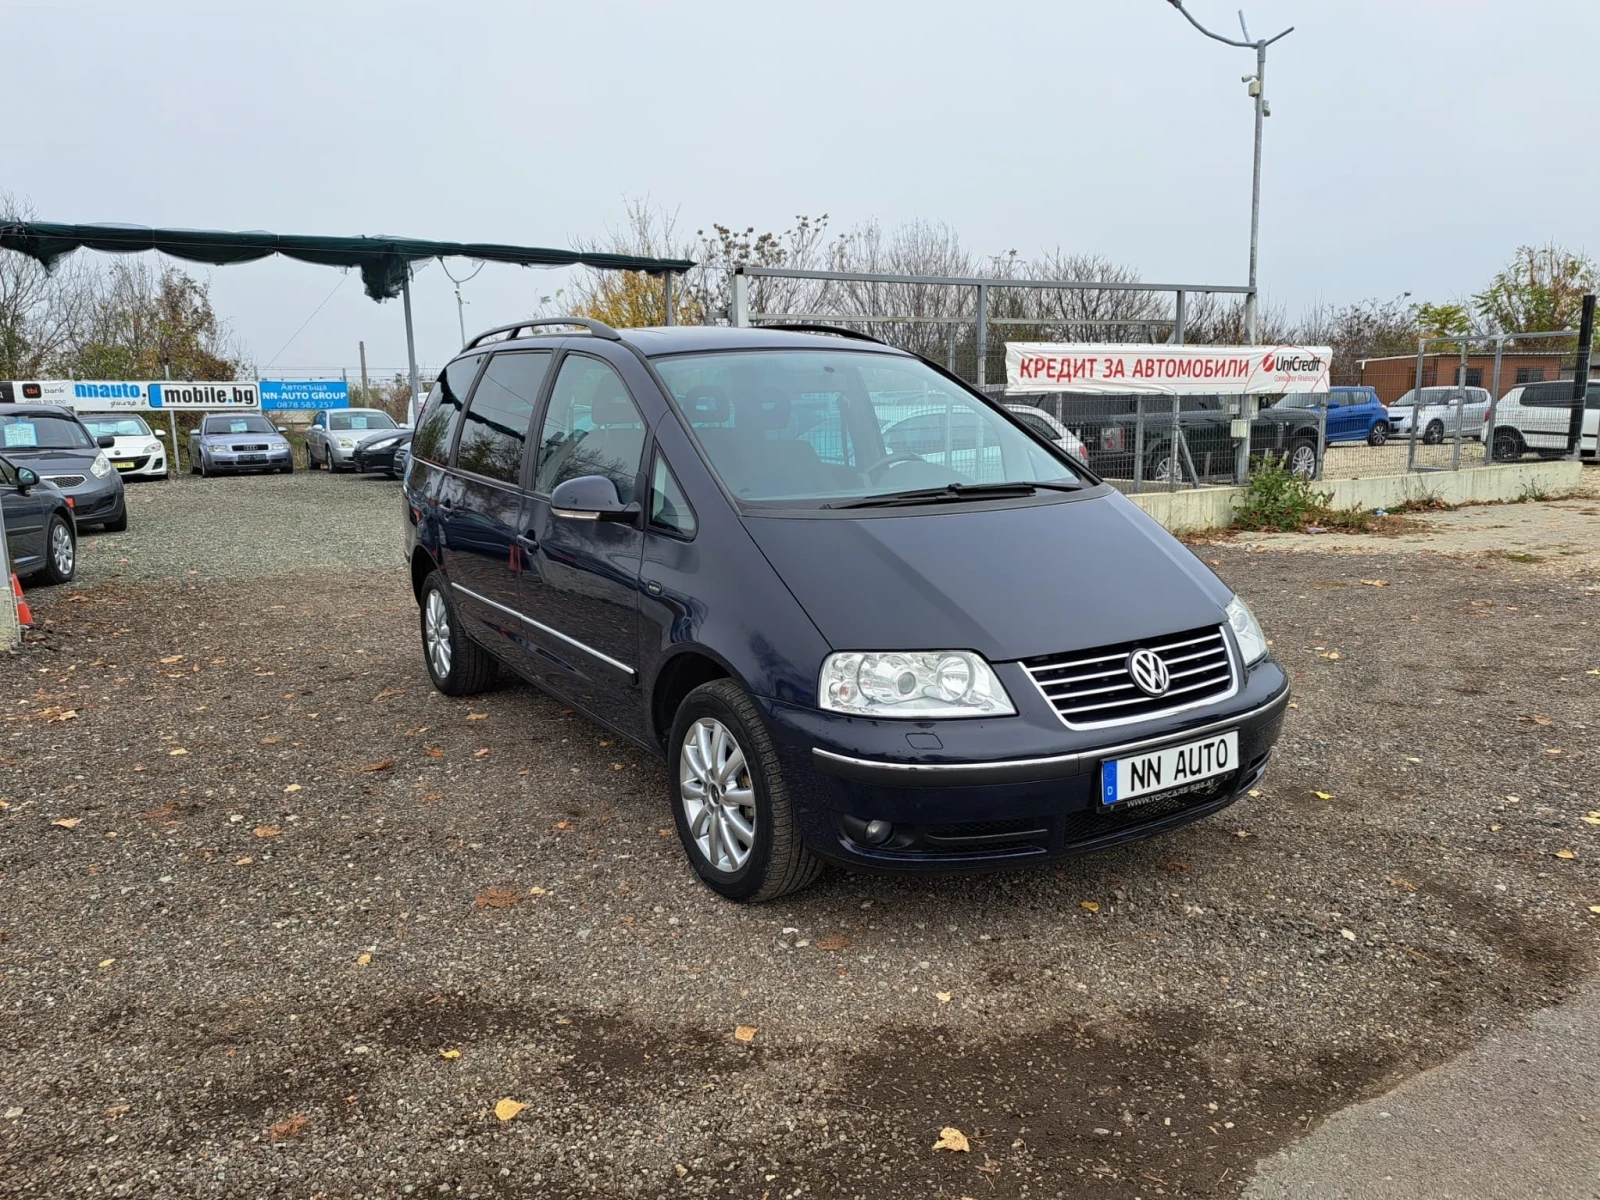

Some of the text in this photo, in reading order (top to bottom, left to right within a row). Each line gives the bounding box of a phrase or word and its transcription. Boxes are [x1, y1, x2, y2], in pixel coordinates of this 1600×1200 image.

[1275, 356, 1321, 372] UniCredit
[1020, 358, 1250, 383] КРЕДИТ ЗА АВТОМОБИЛИ
[26, 387, 39, 395] tbi
[281, 383, 327, 392] Автокъща
[164, 387, 254, 405] mobile.bg
[262, 392, 347, 400] NN-AUTO GROUP
[276, 401, 334, 409] 0878 585 257
[1130, 738, 1229, 792] NN AUTO
[1107, 786, 1114, 796] D
